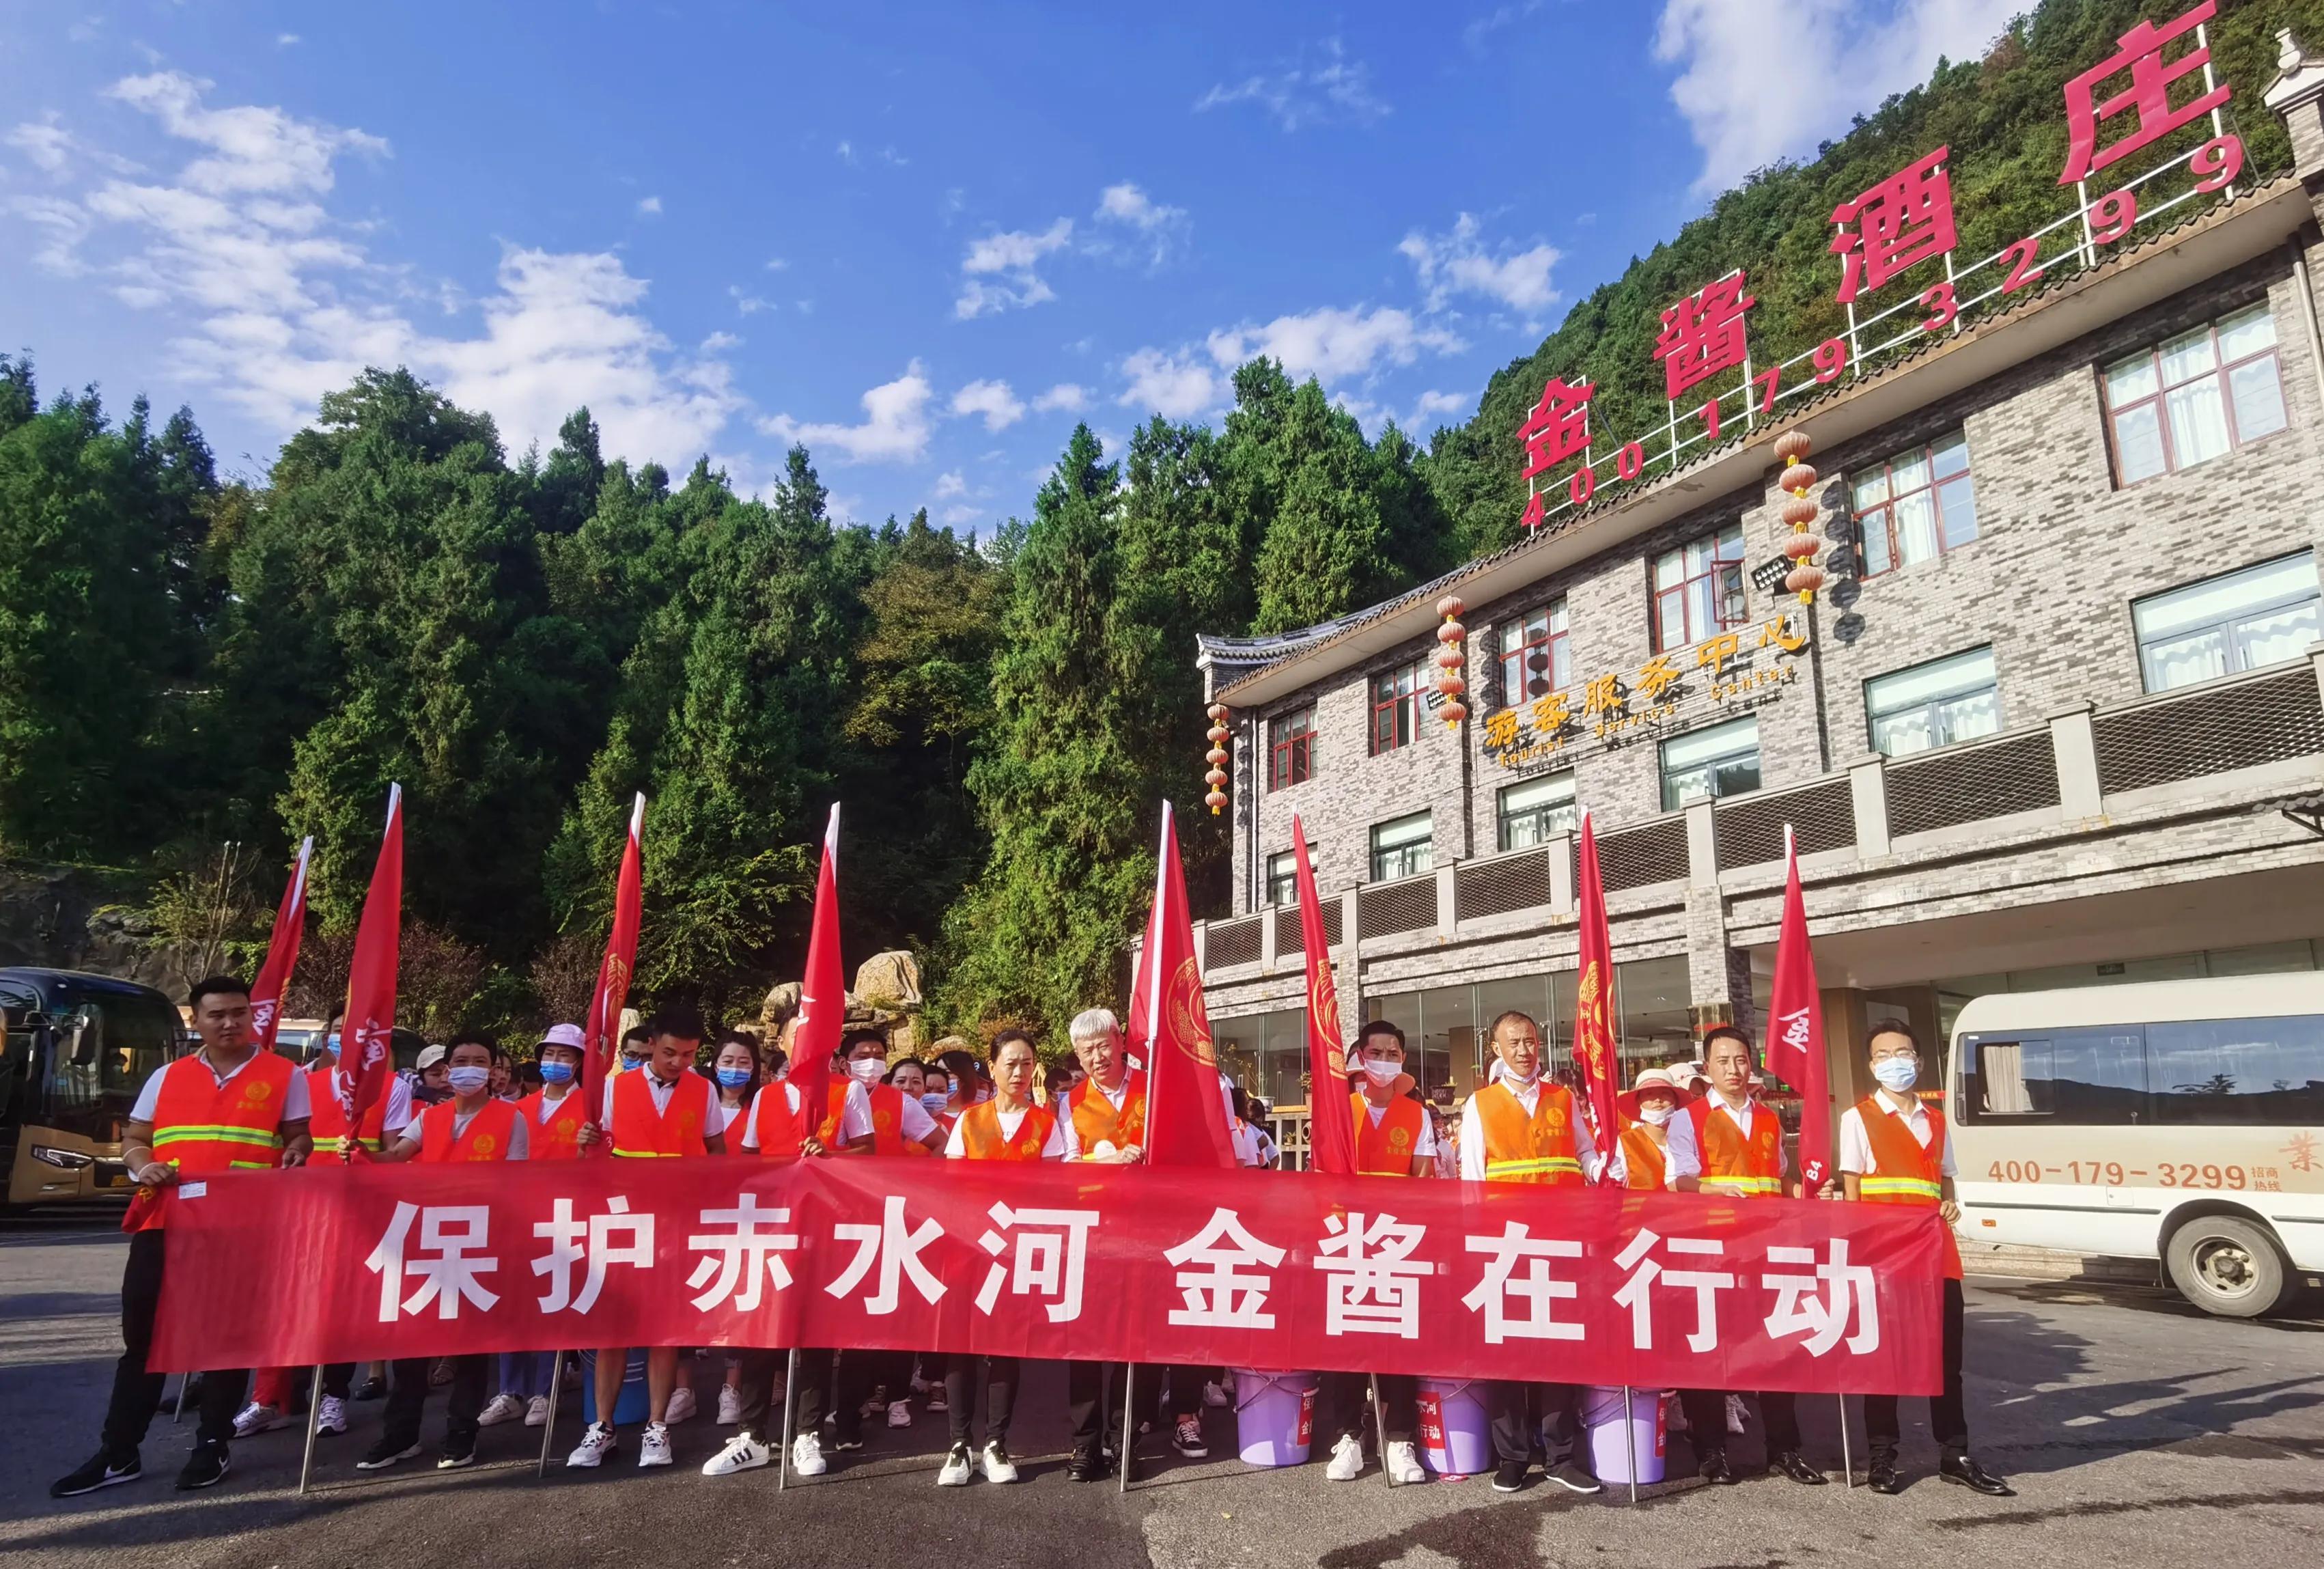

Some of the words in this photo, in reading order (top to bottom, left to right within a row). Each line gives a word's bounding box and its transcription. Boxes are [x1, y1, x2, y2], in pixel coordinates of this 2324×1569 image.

[1516, 0, 2231, 480] 金酱酒庄
[1520, 135, 2243, 527] 4001793299
[1485, 613, 1806, 747] 游客服务中心
[1500, 736, 1564, 767] Tourist
[1595, 704, 1675, 737] Service
[1710, 665, 1794, 699] Center
[1988, 1161, 2246, 1191] 400-179-3299
[2251, 1167, 2278, 1179] 招商
[365, 1193, 1100, 1322] 保护赤水河
[1163, 1207, 1879, 1357] 金酱在行动
